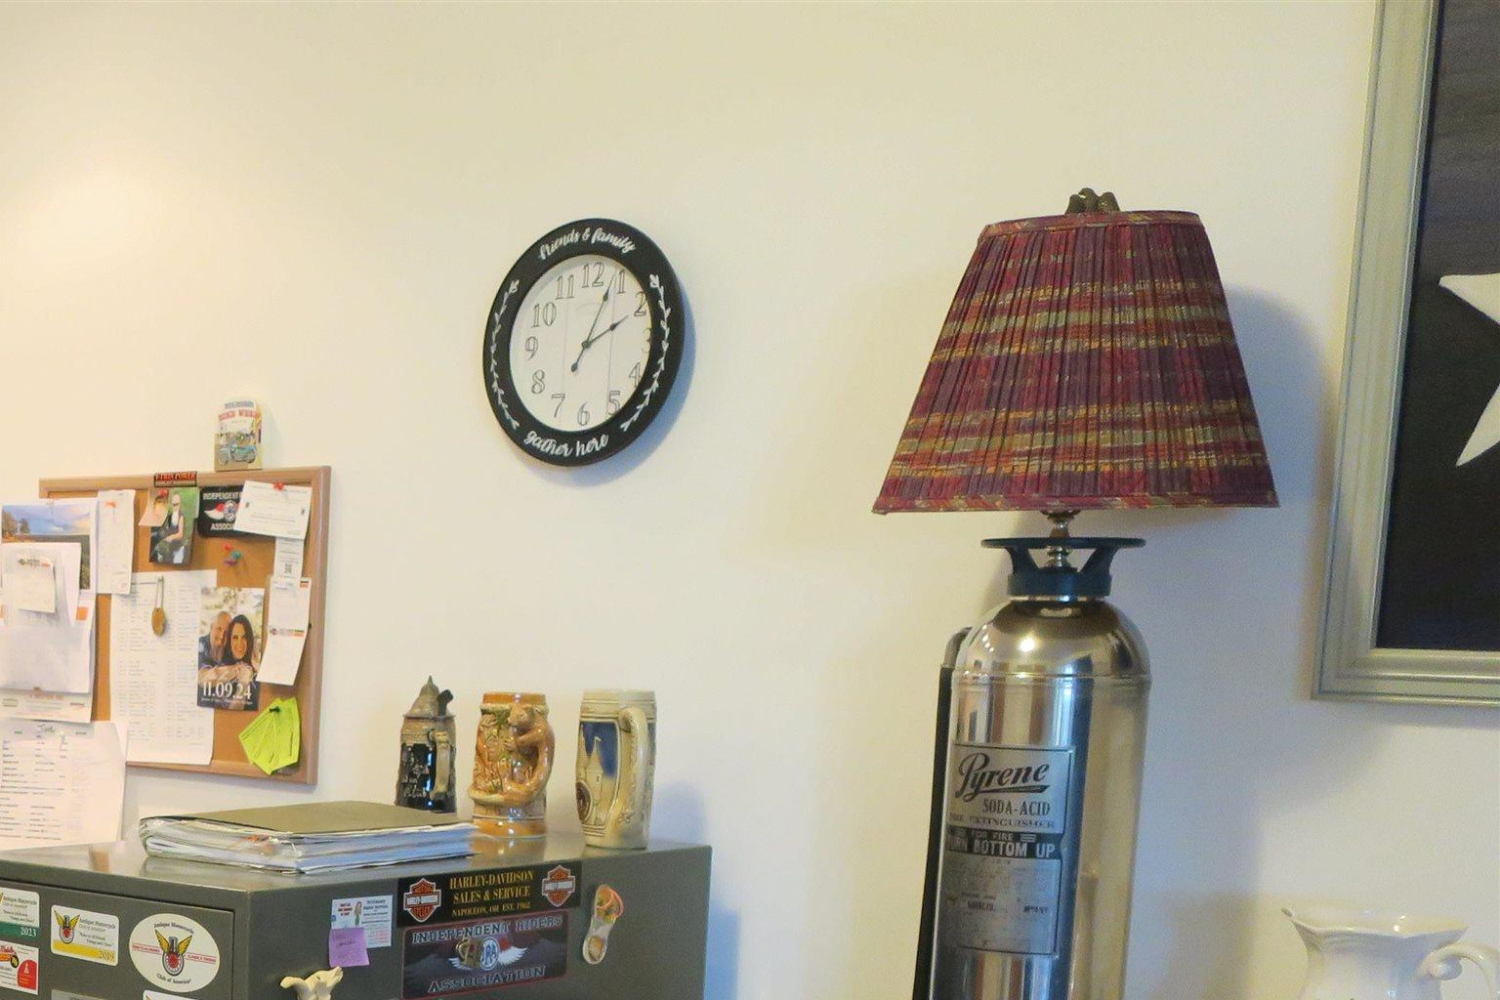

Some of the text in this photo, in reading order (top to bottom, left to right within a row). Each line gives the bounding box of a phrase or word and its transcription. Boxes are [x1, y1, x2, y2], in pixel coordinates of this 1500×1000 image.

[538, 229, 581, 260] friends
[591, 227, 636, 253] family
[555, 274, 575, 300] 11
[581, 262, 605, 288] 12
[617, 269, 626, 294] 1
[531, 302, 557, 328] 10
[633, 291, 648, 317] 2
[525, 337, 539, 361] 9
[531, 369, 546, 395] 8
[628, 362, 642, 388] 4
[551, 393, 566, 418] 7
[577, 402, 591, 427] 6
[605, 390, 621, 416] 5
[524, 431, 609, 457] gather here
[955, 752, 1050, 802] Pyrene
[983, 799, 1050, 817] SODA-ACID
[973, 839, 1028, 857] BOTTOM
[1036, 842, 1056, 859] UP
[993, 832, 1014, 841] FIRE
[450, 870, 534, 889] HARLEY-DAVIDSON
[453, 890, 482, 904] SALES
[483, 889, 490, 901] &
[493, 886, 531, 900] SERVICE
[412, 920, 512, 945] INDEPENDENT
[515, 915, 563, 932] RIDERS
[428, 964, 546, 993] ASSOCIATION
